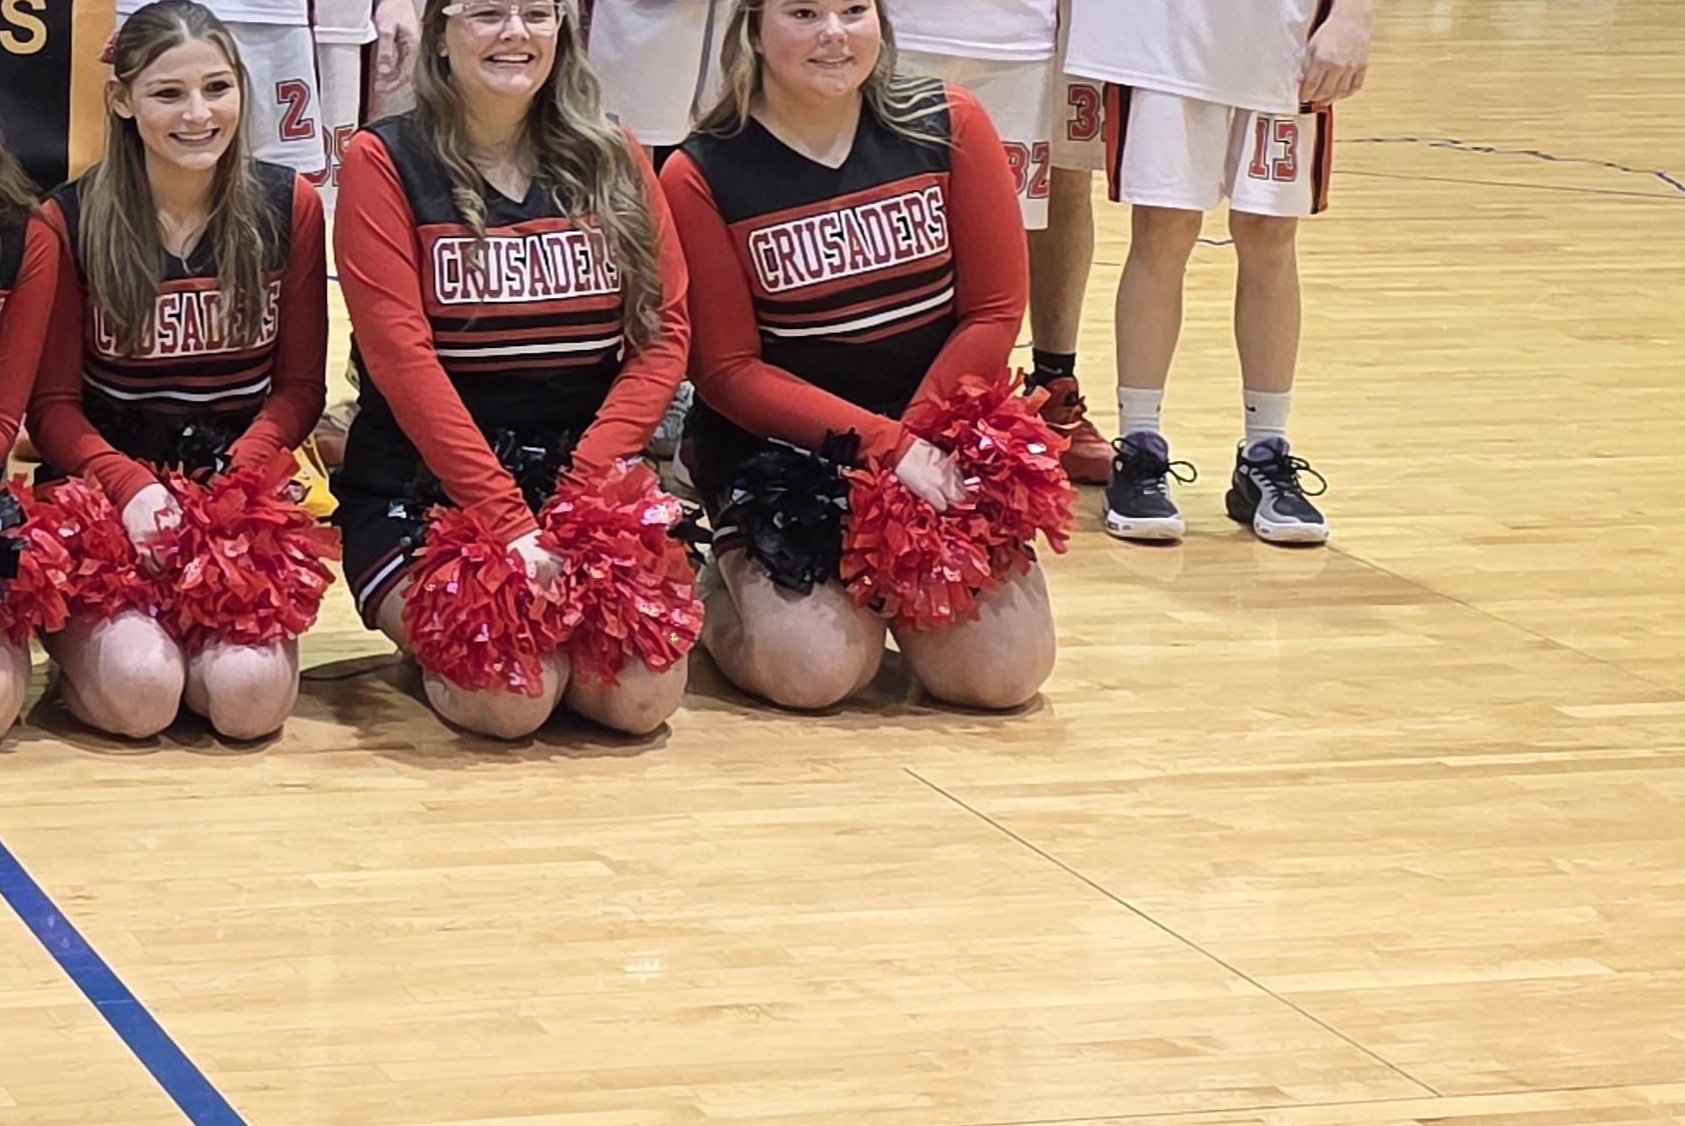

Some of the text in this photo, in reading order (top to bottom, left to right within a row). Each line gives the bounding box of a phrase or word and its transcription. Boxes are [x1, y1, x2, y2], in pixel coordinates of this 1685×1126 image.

[275, 78, 315, 142] 2
[1067, 83, 1106, 142] 3
[1248, 116, 1298, 182] 13
[748, 186, 950, 294] CRUSADERS
